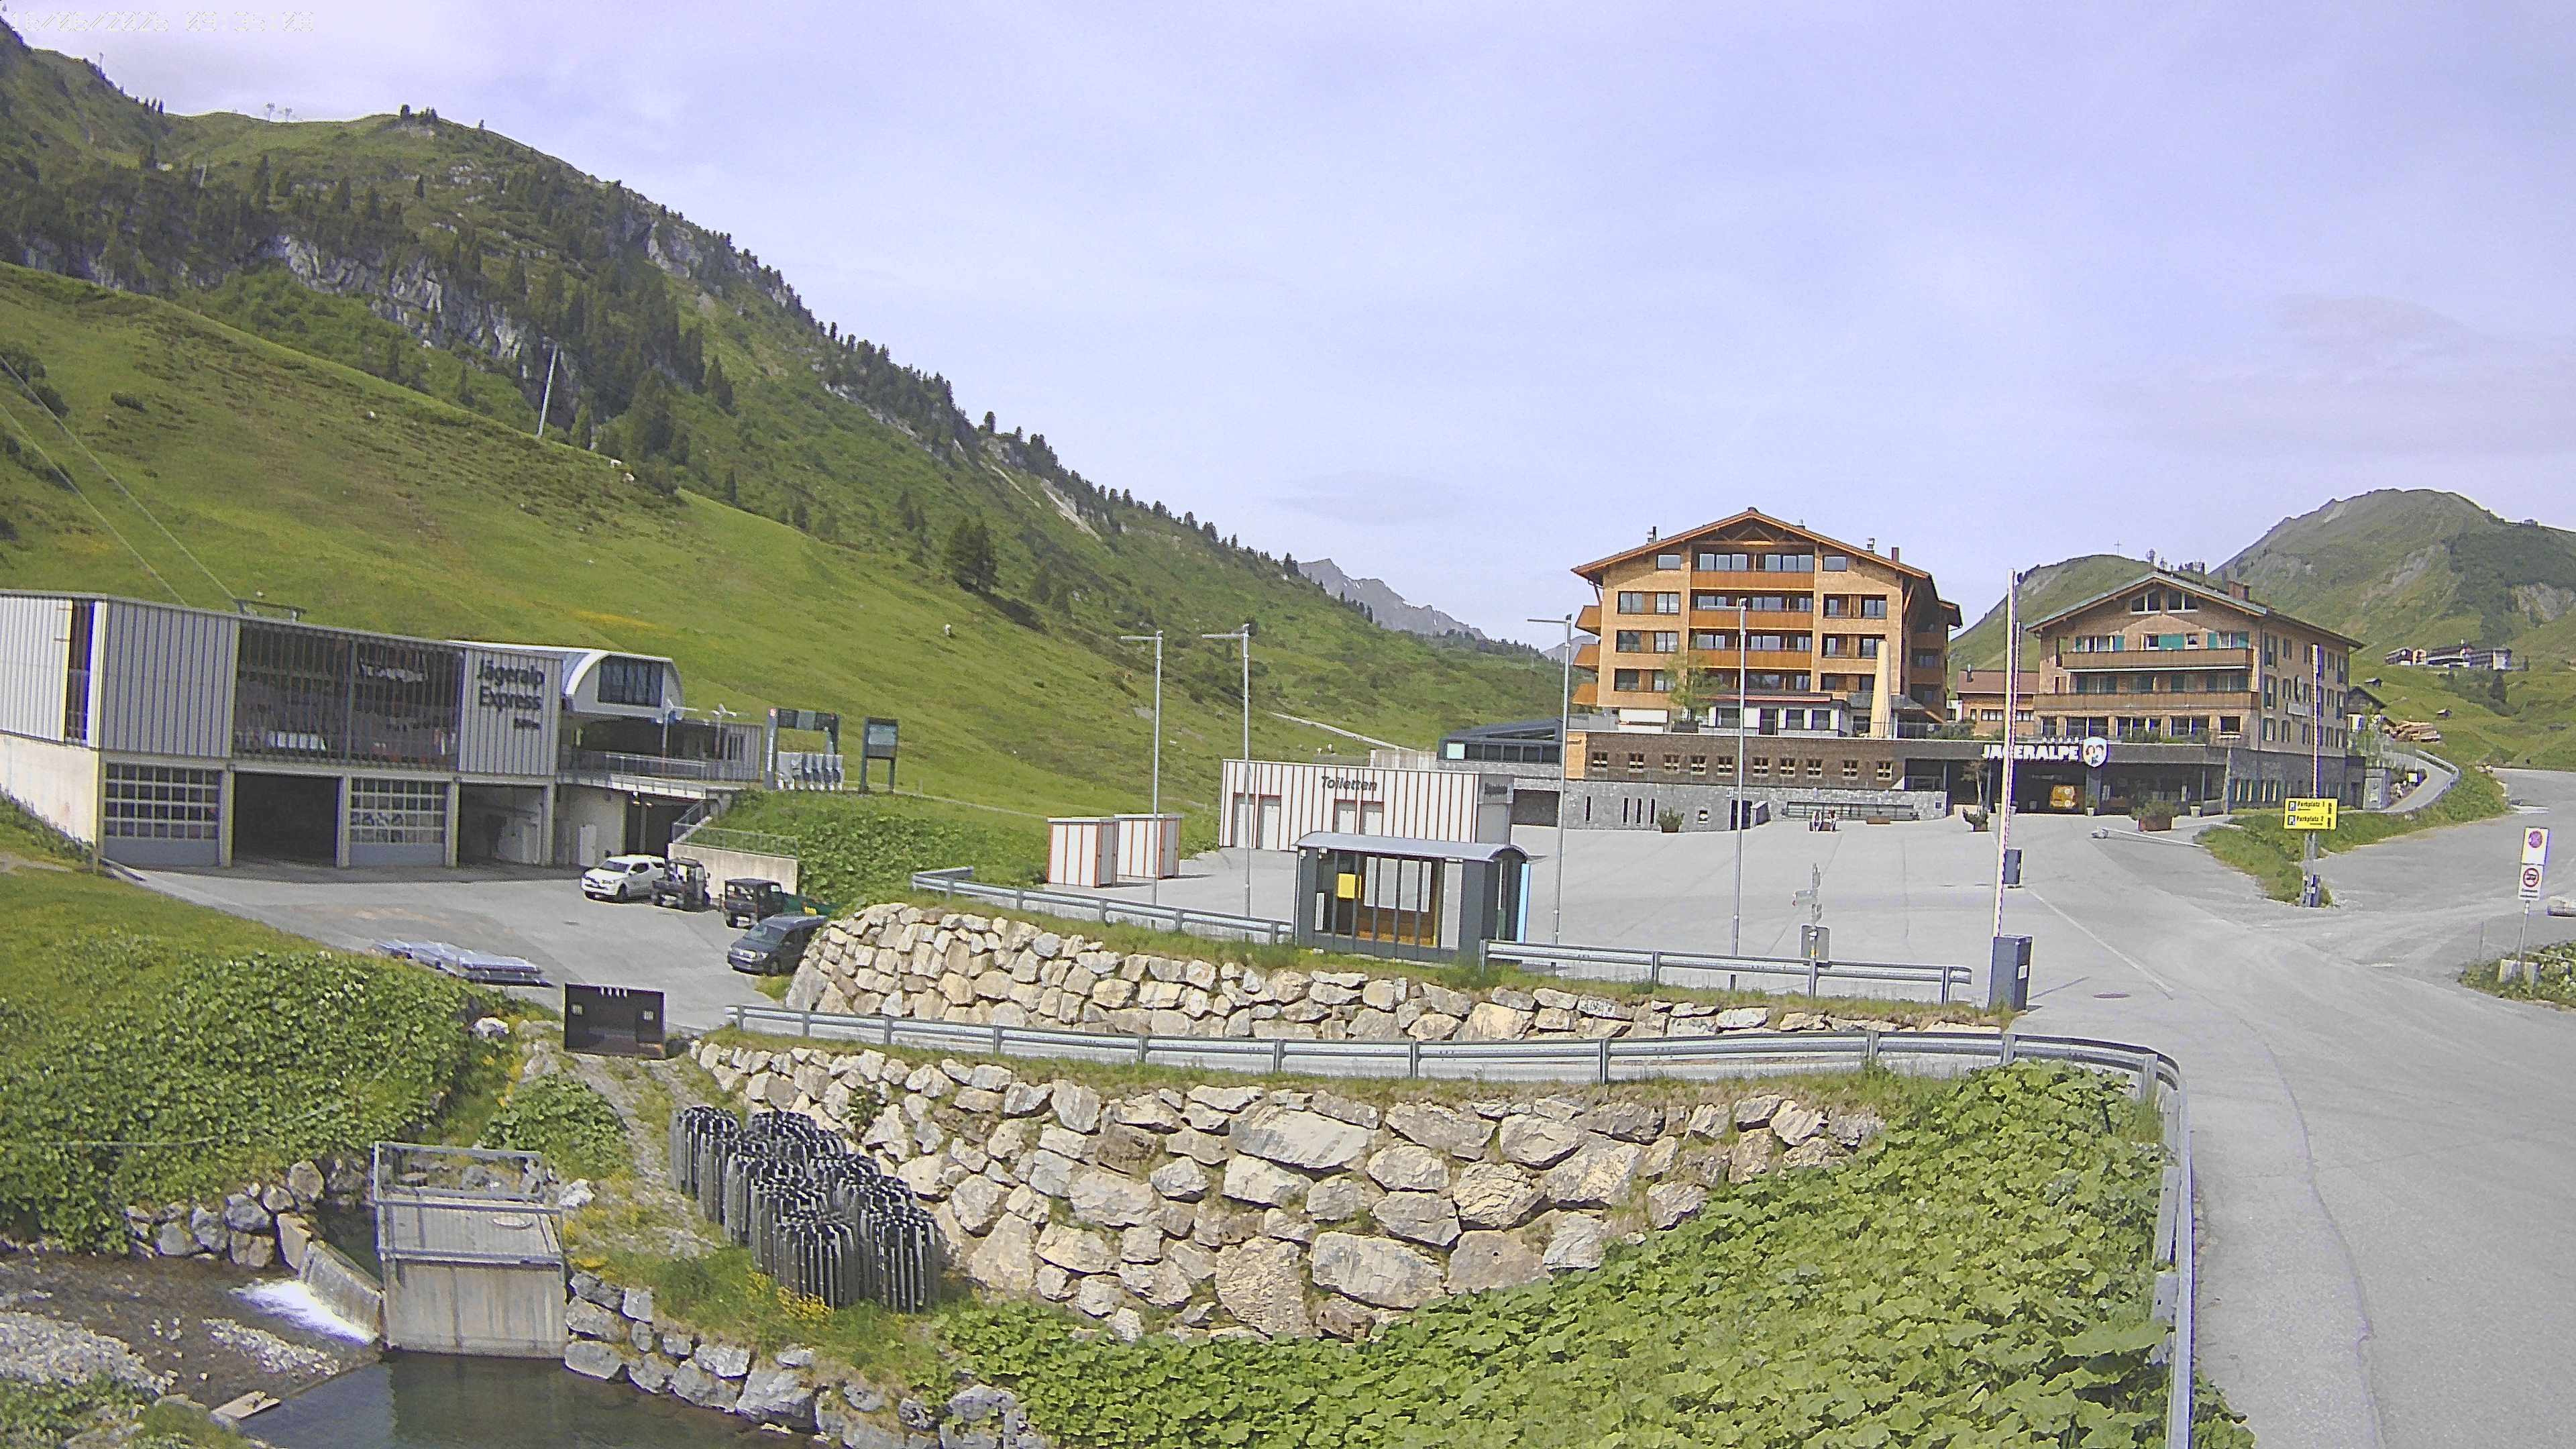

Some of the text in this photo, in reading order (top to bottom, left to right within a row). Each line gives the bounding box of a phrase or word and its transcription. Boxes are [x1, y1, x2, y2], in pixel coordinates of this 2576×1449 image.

[477, 659, 545, 690] Jägeralp
[479, 684, 543, 711] Express
[1322, 776, 1377, 791] Toiletten
